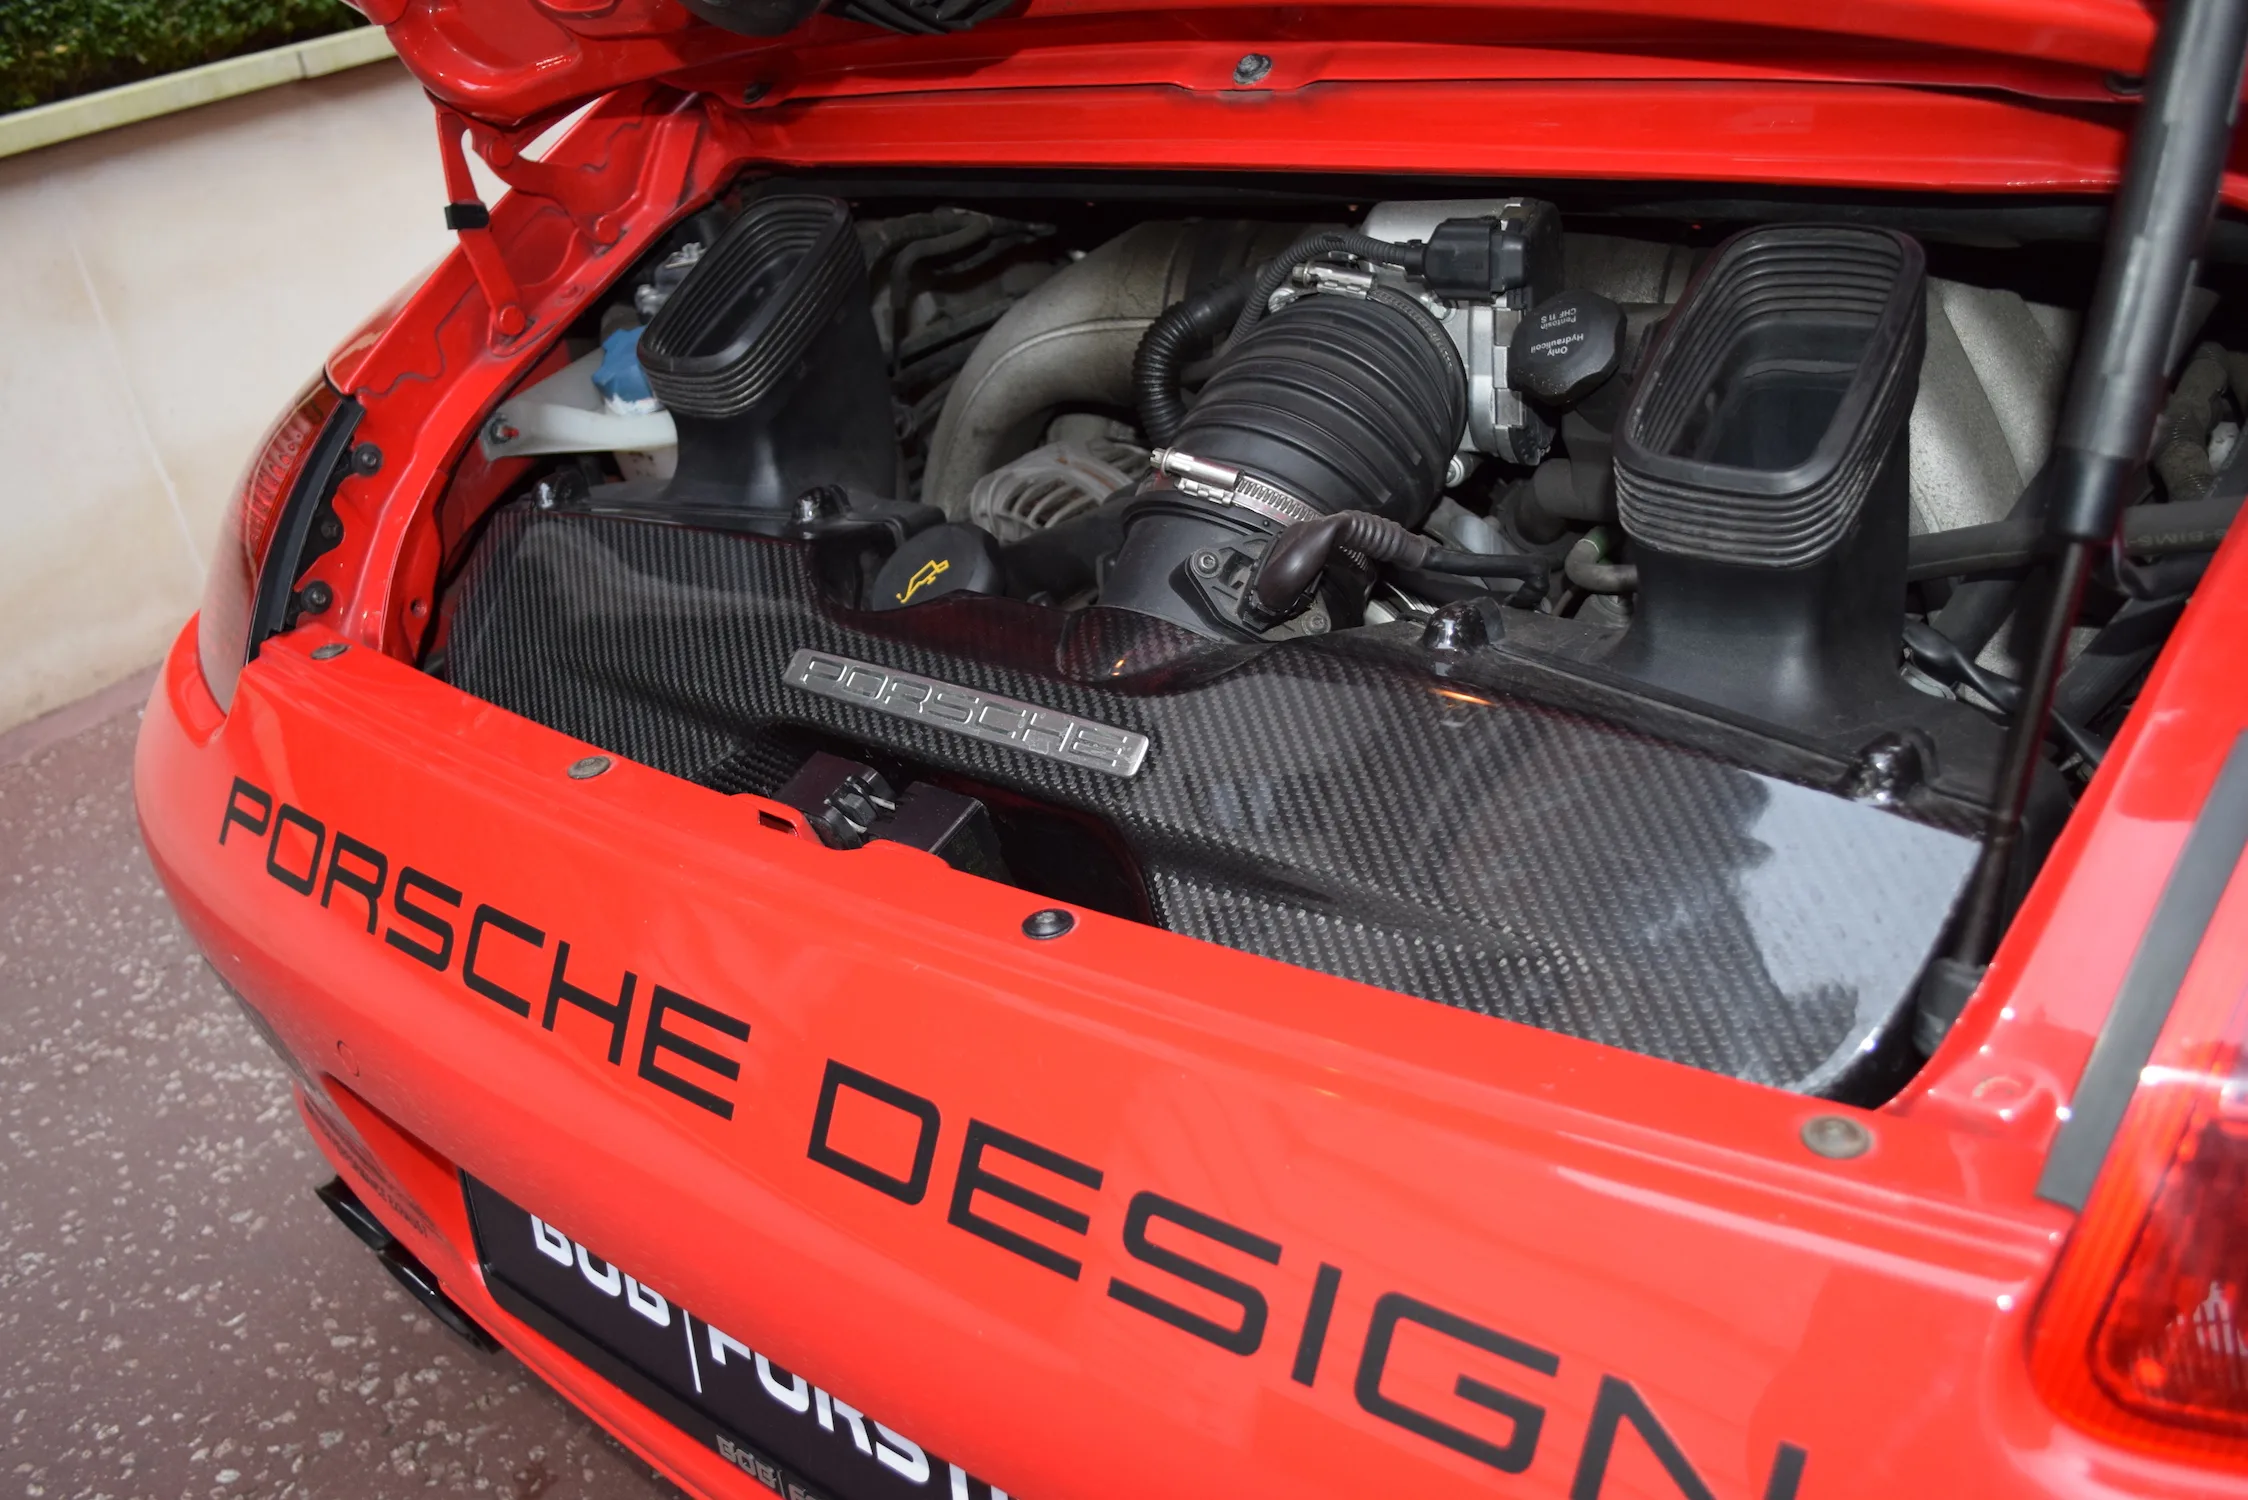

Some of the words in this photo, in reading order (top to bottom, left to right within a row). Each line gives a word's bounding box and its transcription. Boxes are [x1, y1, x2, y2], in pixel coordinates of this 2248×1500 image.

[1540, 315, 1577, 330] Pentosin
[1559, 307, 1577, 319] CHF
[1530, 332, 1584, 354] Hydraulicoil
[1546, 345, 1568, 357] Only
[803, 656, 1130, 767] PORSCHE
[219, 776, 752, 1121] PORSCHE
[806, 1058, 1809, 1500] DESIGN
[716, 1434, 777, 1490] BOB
